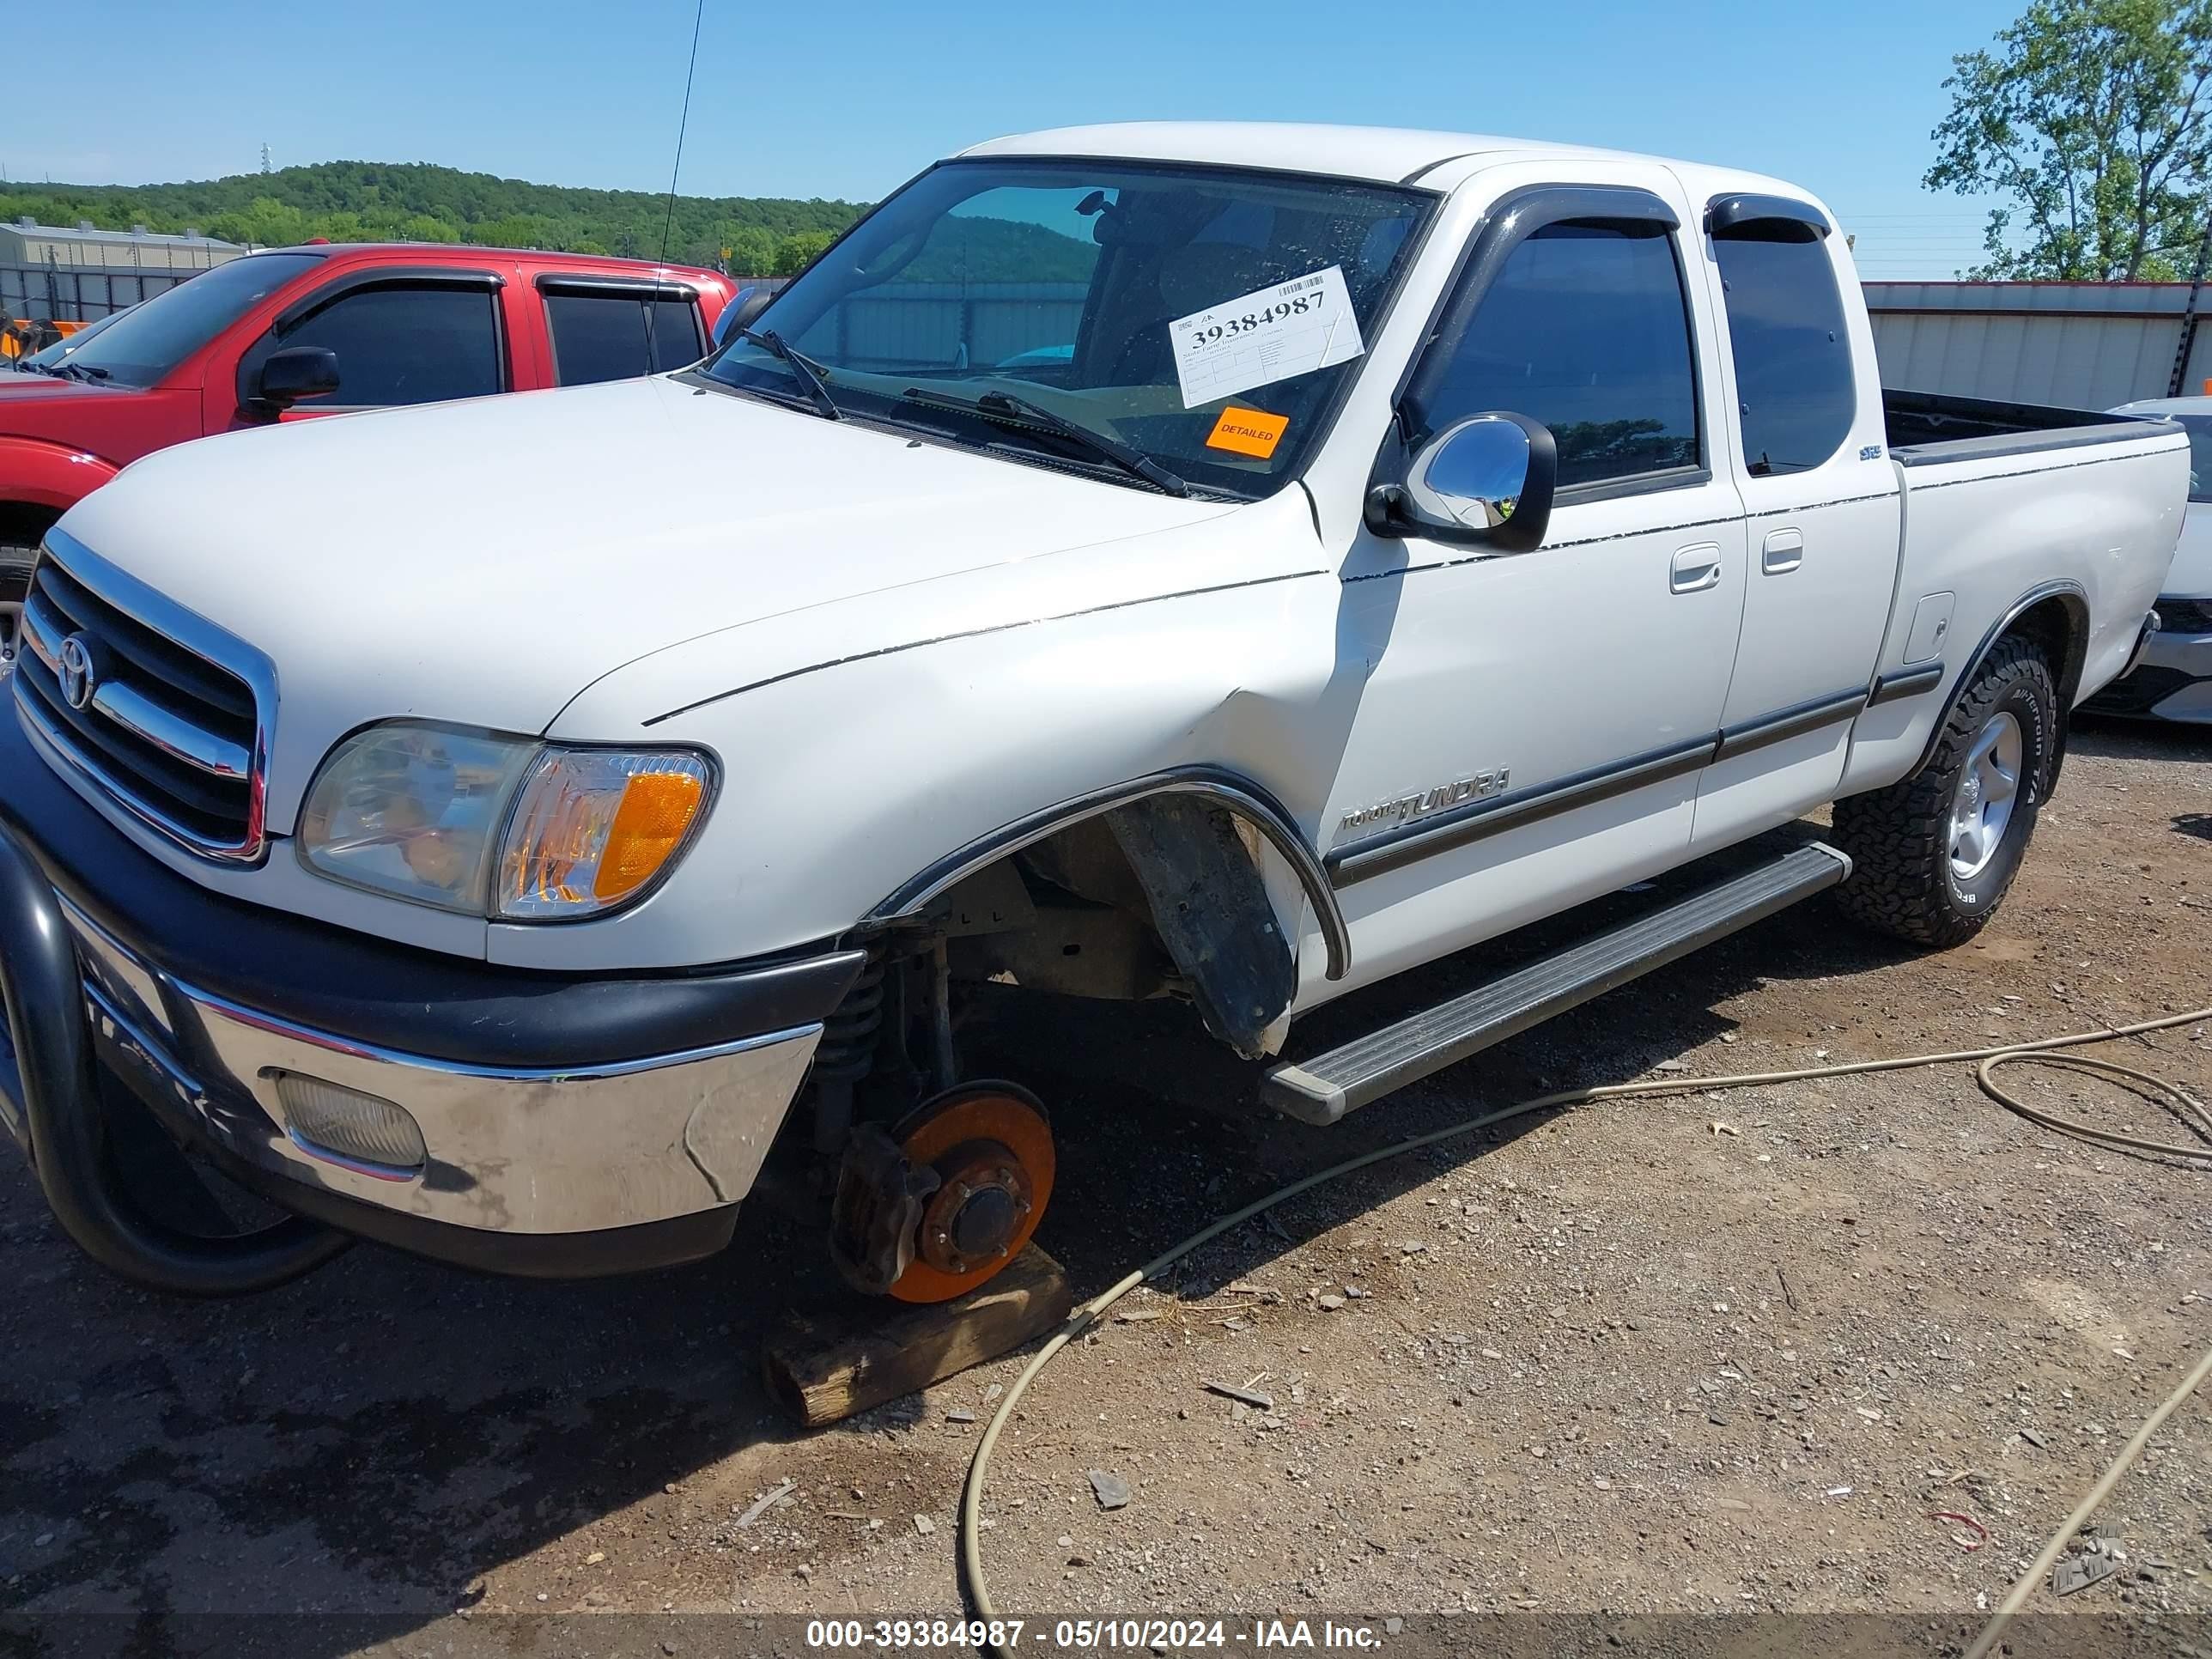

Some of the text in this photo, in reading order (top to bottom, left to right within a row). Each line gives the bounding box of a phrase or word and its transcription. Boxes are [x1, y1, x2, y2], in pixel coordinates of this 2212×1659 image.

[1190, 290, 1324, 349] 39384987
[1220, 422, 1274, 442] DETAILED
[1395, 766, 1511, 821] TUNDRA
[2027, 767, 2041, 805] T/A
